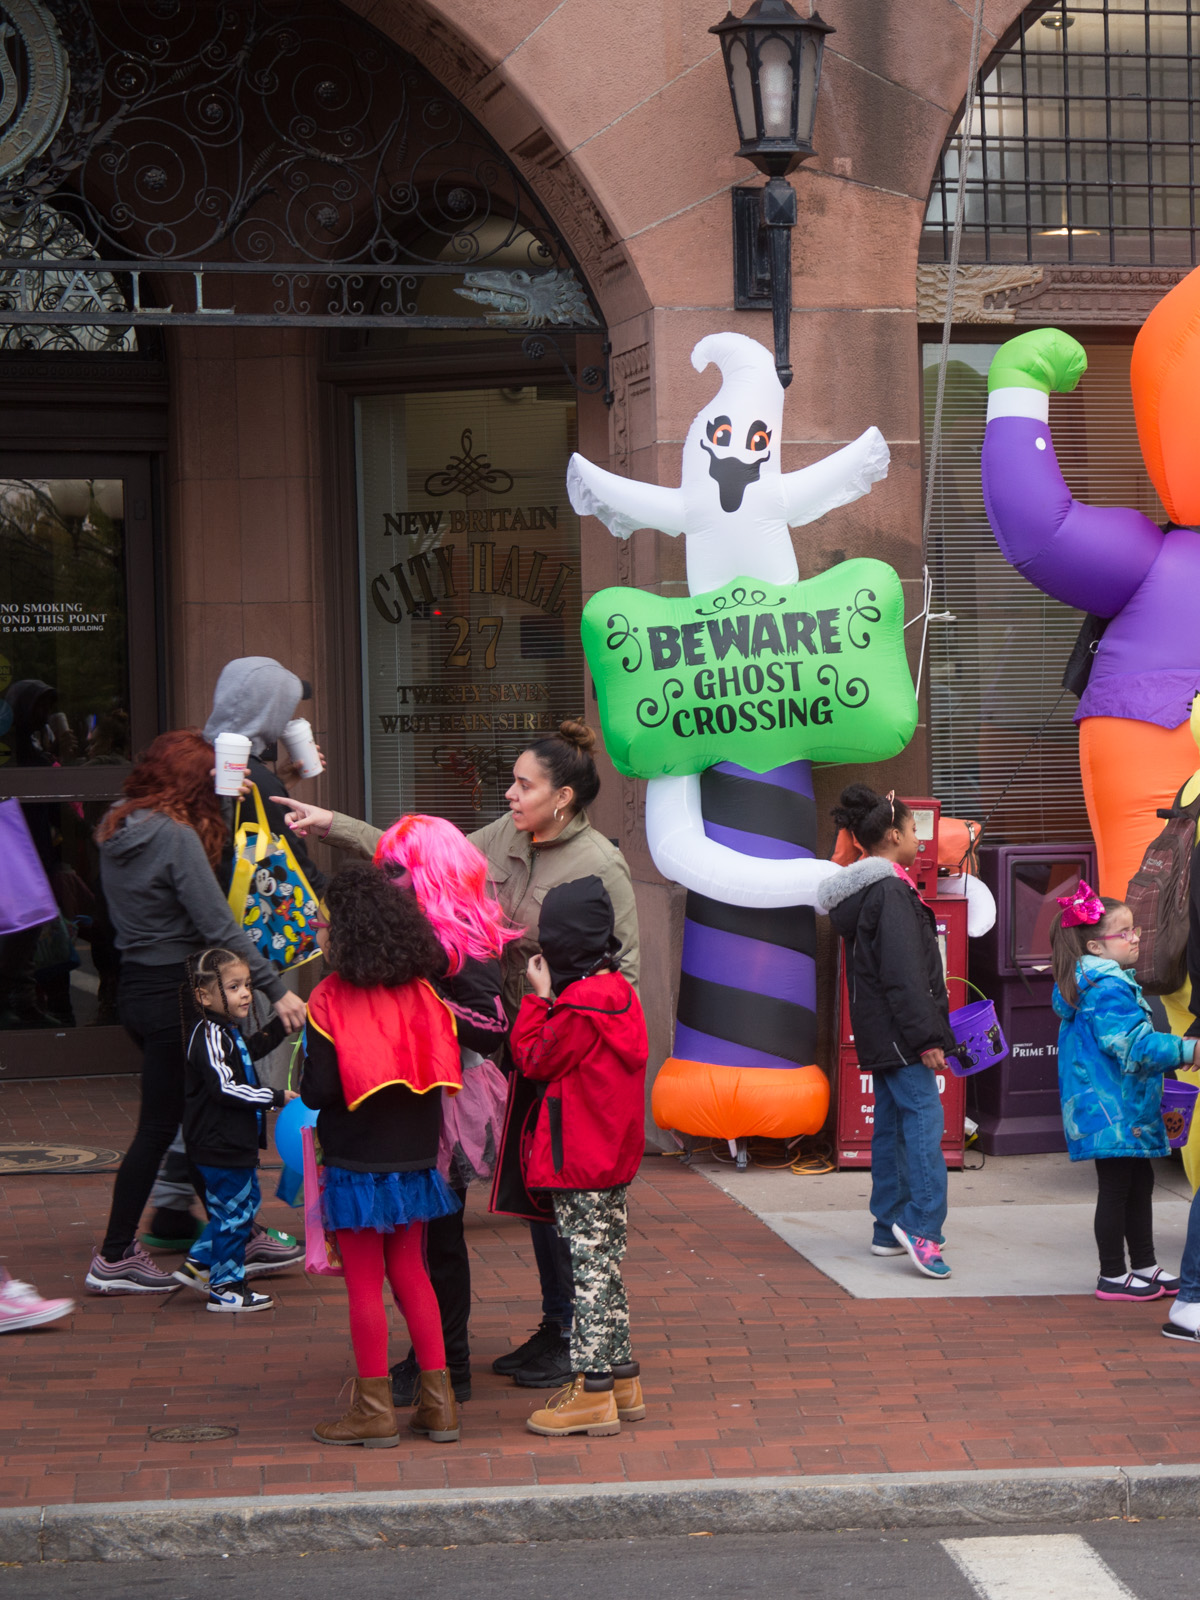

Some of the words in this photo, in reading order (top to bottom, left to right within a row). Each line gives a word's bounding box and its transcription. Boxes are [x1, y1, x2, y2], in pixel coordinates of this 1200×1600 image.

[383, 511, 443, 536] NEW
[449, 506, 558, 533] BRITAIN
[371, 544, 458, 624] CITY
[470, 542, 574, 618] HALL
[0, 603, 19, 613] NO
[23, 603, 82, 613] SMOKING
[34, 614, 64, 624] THIS
[69, 613, 107, 623] POINT
[444, 616, 503, 669] 27
[647, 608, 843, 671] BEWARE
[397, 684, 483, 704] TWENTY
[489, 683, 551, 702] SEVEN
[694, 661, 803, 700] GHOST
[378, 714, 432, 733] WEST
[439, 712, 492, 732] MAIN
[672, 696, 833, 738] CROSSING
[1012, 1046, 1044, 1057] PRIME
